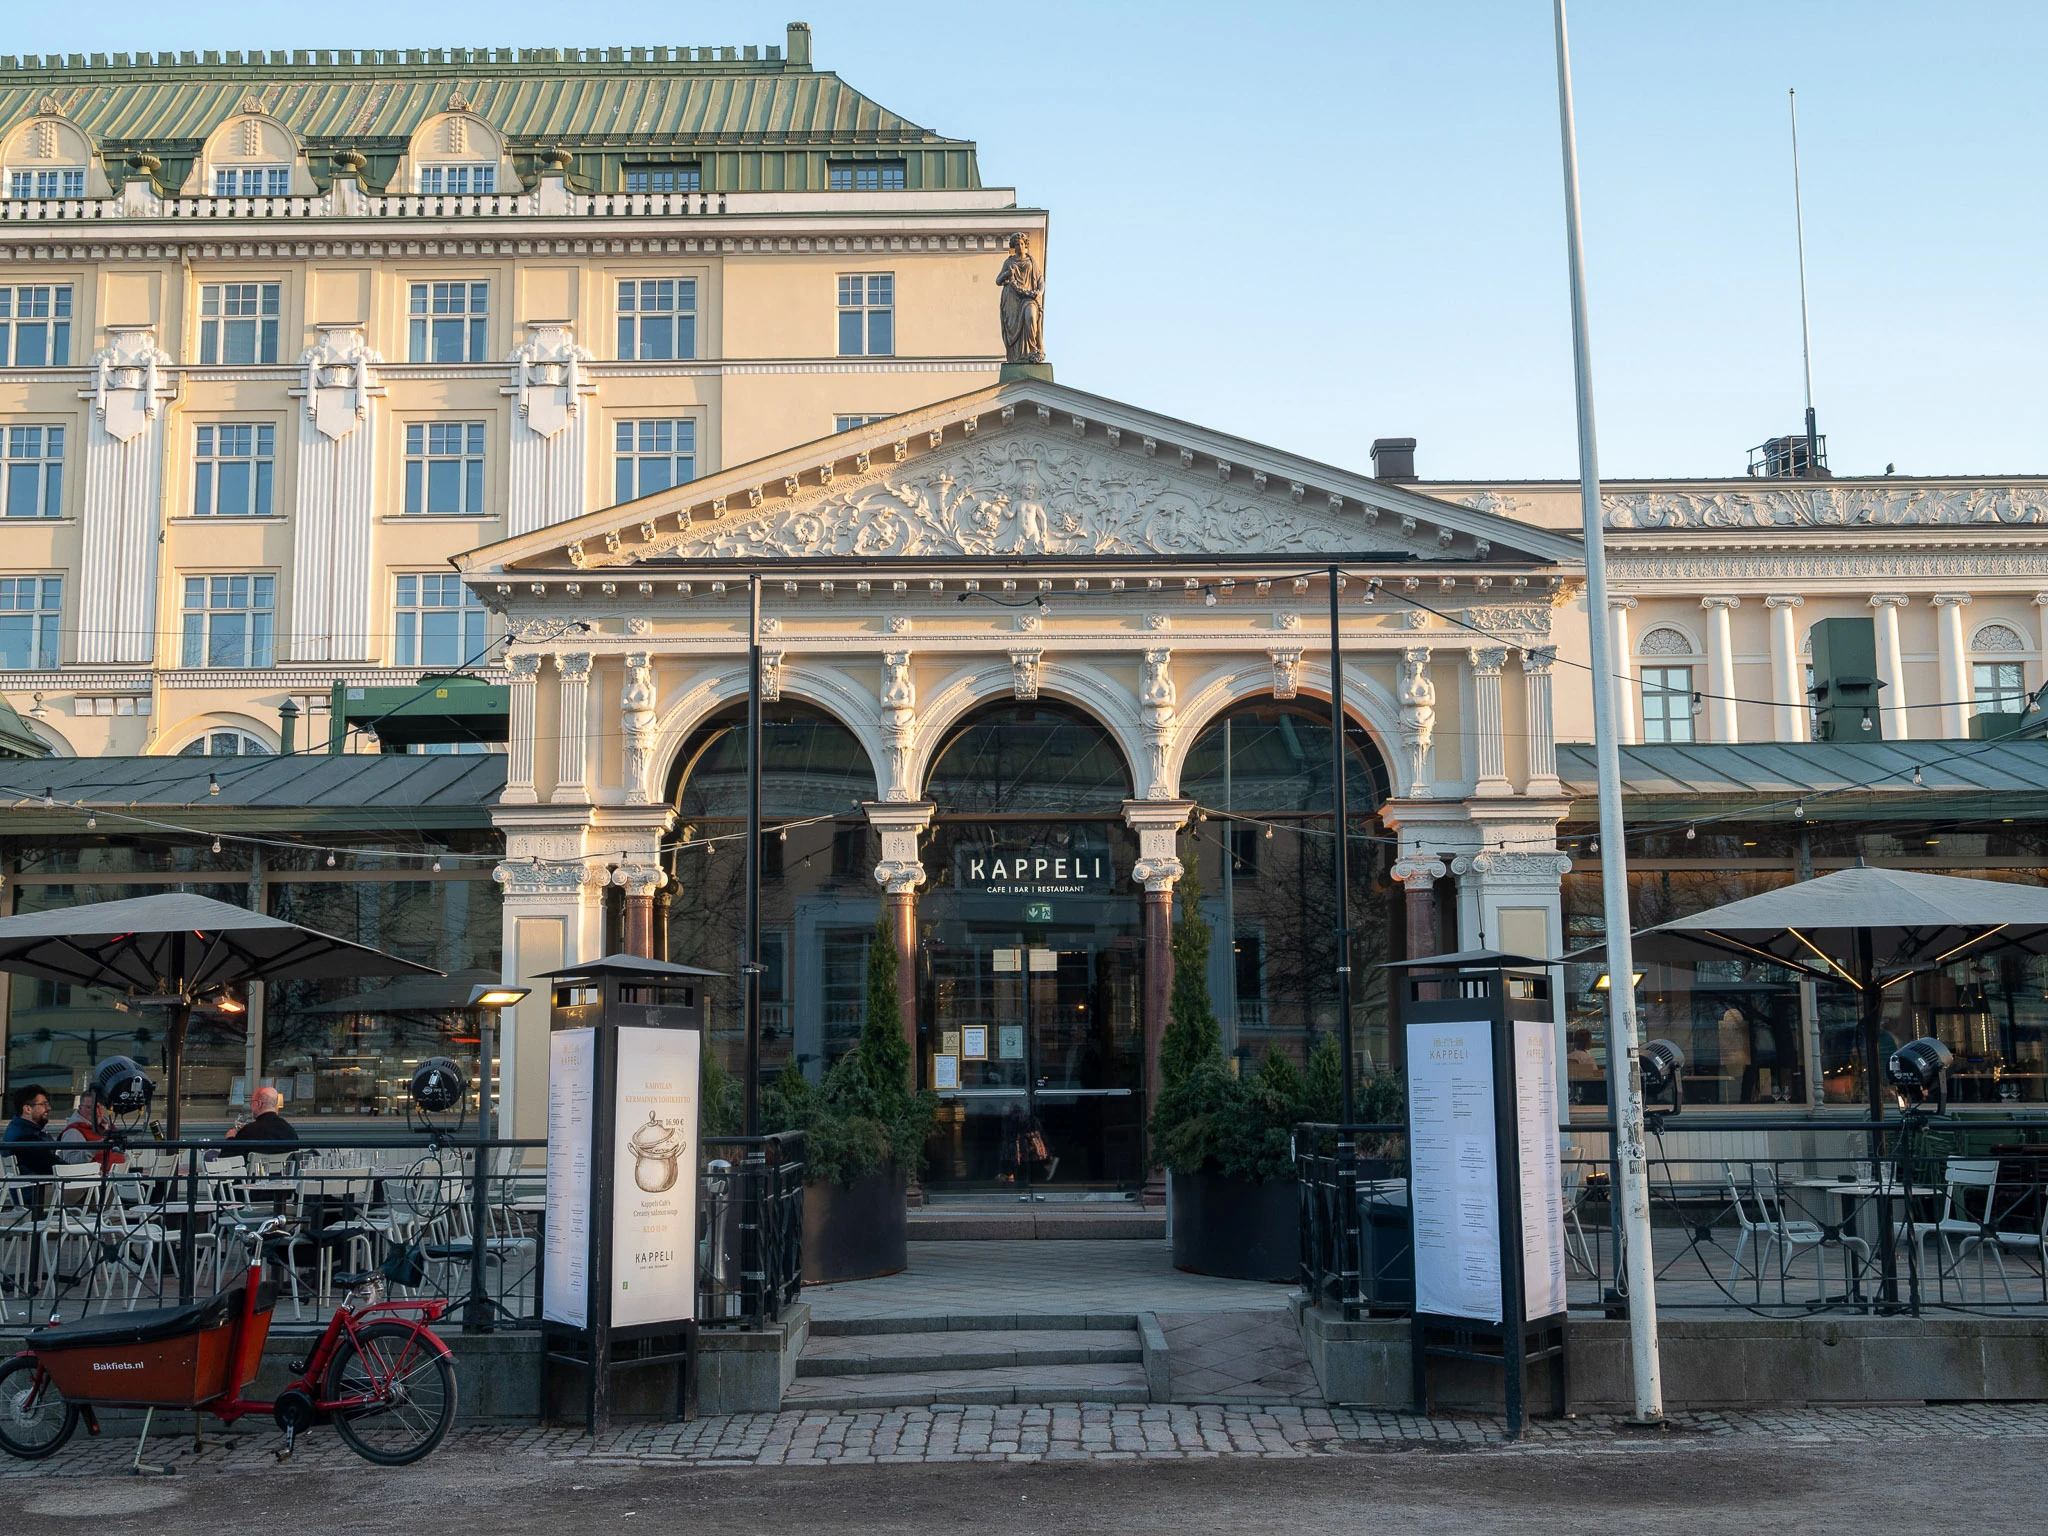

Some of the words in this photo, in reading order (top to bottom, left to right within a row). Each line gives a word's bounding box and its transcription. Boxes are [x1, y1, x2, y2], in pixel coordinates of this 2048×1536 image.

[971, 857, 1100, 880] KAPPELI
[986, 886, 1006, 894] CAFE
[1037, 885, 1085, 893] RESTAURANT
[1429, 1049, 1469, 1060] KAPPELI
[645, 1081, 673, 1090] KAHVILAN
[625, 1095, 658, 1104] KERMAINEN
[659, 1095, 691, 1104] LOHIKEITTO
[641, 1200, 659, 1209] Kappeli
[633, 1210, 650, 1218] Creamy
[635, 1250, 674, 1264] KAPPELI
[93, 1361, 144, 1371] Bakfiets.nl
